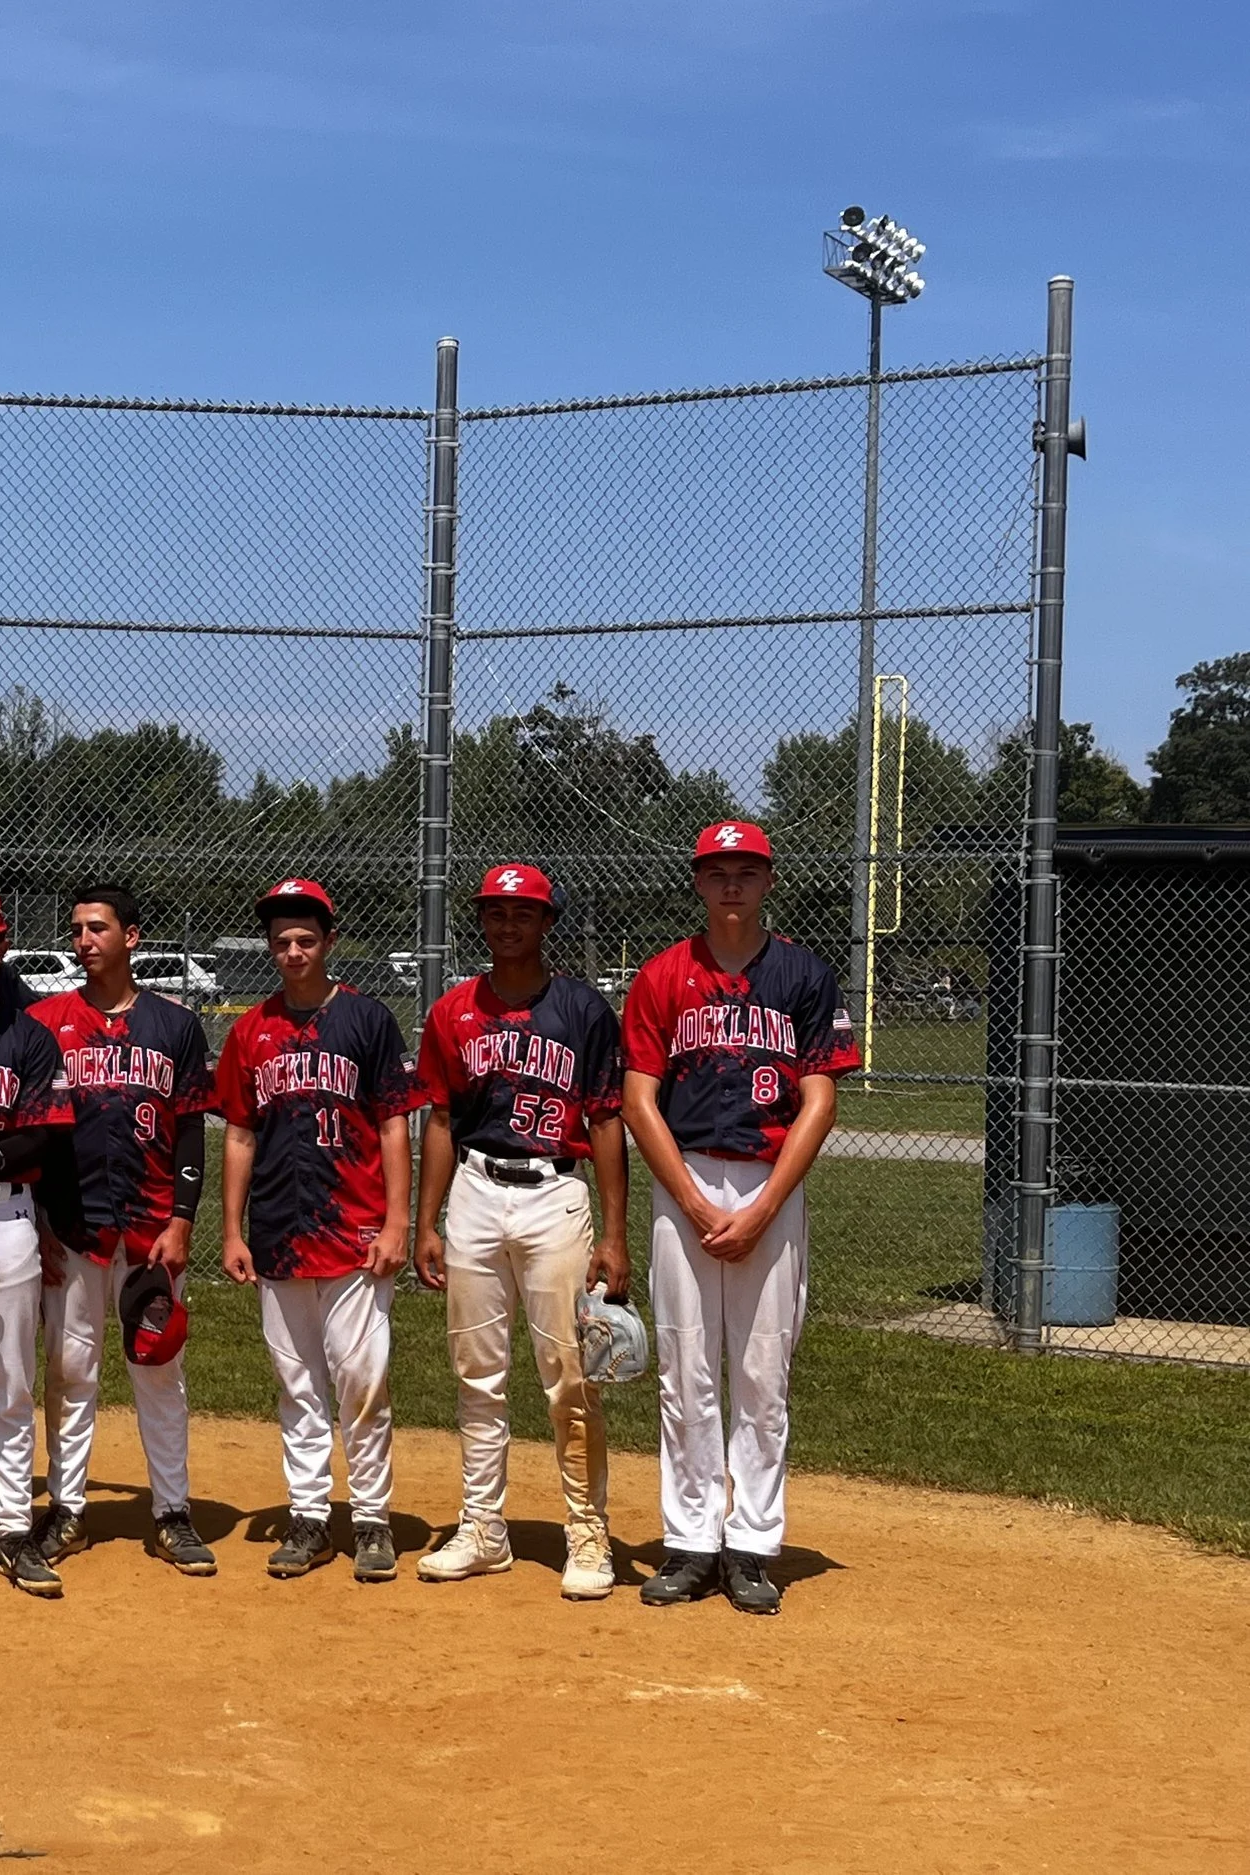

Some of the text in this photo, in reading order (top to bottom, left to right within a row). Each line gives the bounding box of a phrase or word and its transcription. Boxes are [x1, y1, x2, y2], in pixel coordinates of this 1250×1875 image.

[63, 1045, 174, 1098] OCKLAND
[752, 1066, 779, 1105] 8
[134, 1102, 156, 1141] 9
[315, 1107, 343, 1147] 11
[509, 1092, 566, 1141] 52
